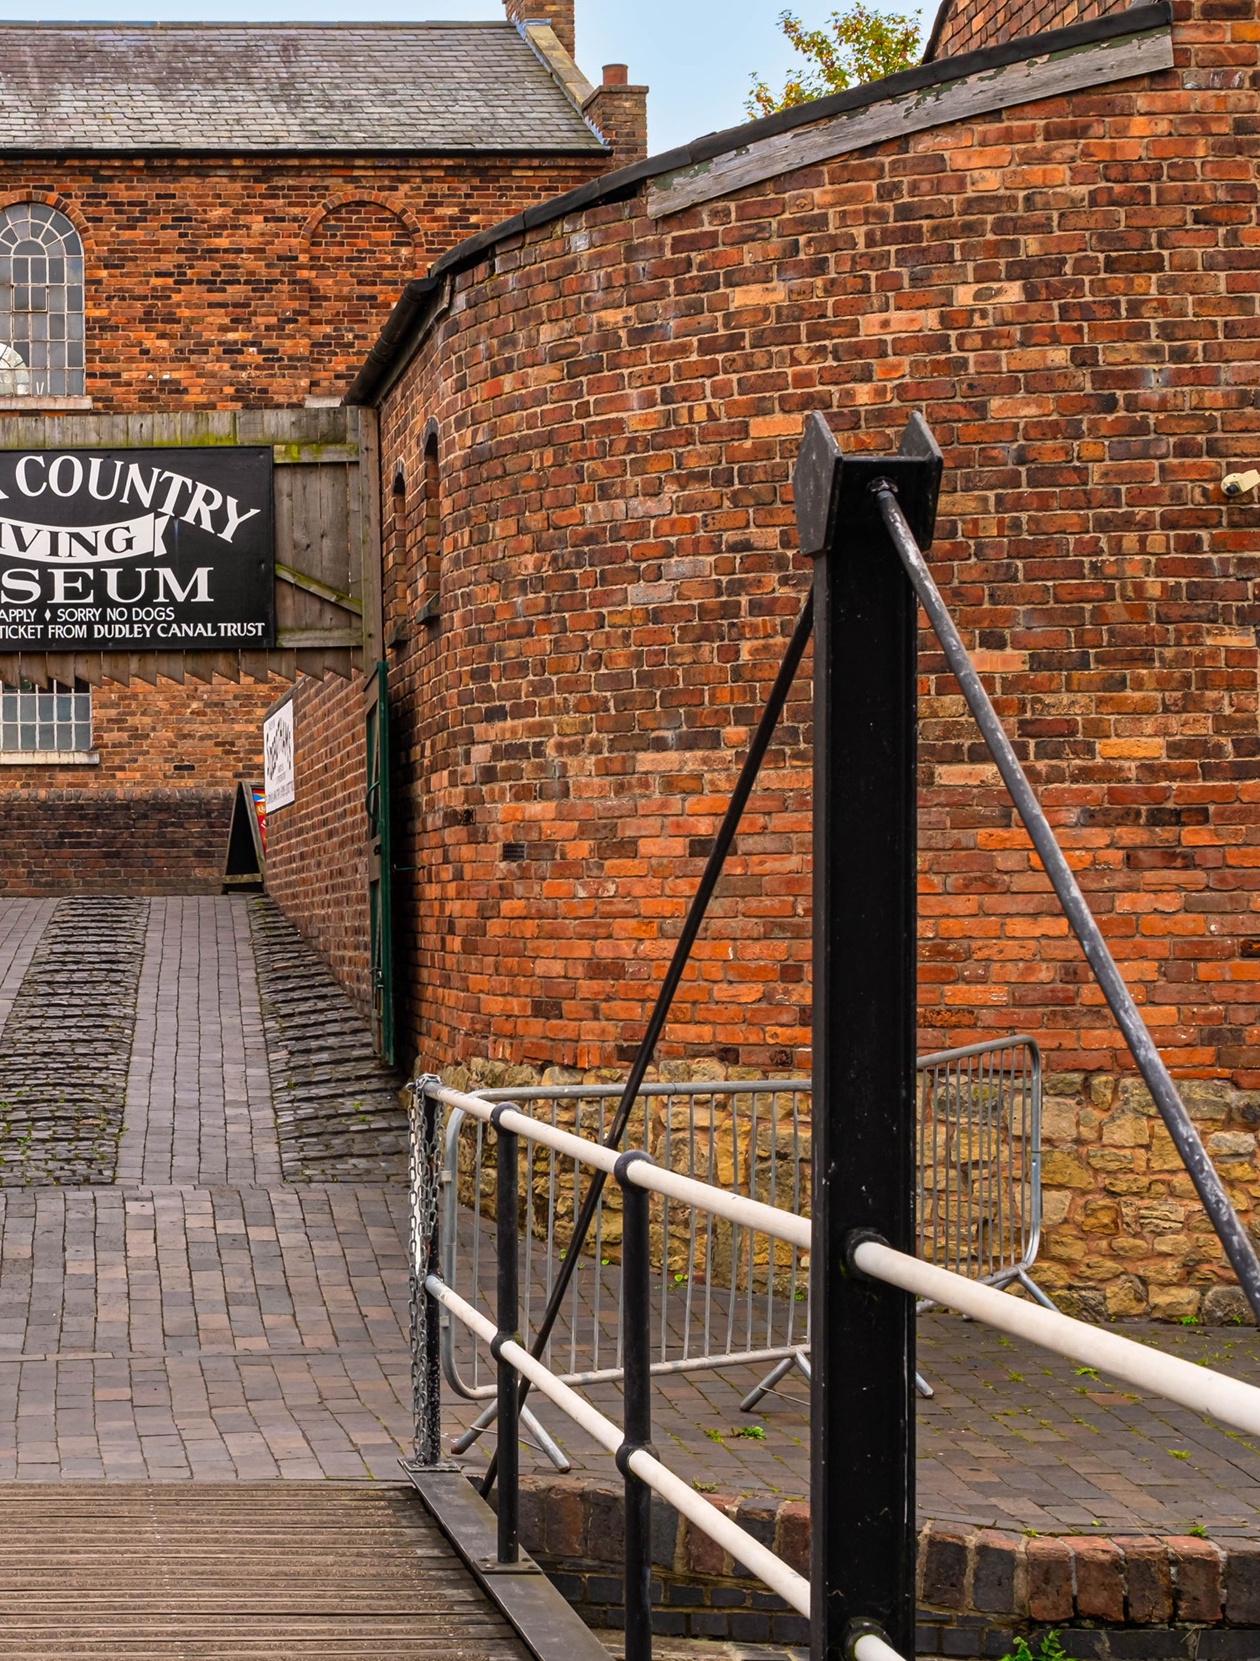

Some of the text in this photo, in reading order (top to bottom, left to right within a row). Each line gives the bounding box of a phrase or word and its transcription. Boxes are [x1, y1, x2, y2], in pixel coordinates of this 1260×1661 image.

[15, 455, 261, 544] COUNTRY
[57, 608, 102, 621] SORRY
[107, 608, 129, 621] NO
[132, 607, 174, 621] DOGS
[0, 625, 44, 639] TICKET
[48, 625, 87, 639] FROM
[94, 624, 155, 638] DUDLEY
[157, 623, 216, 638] CANAL
[218, 623, 264, 637] TRUST
